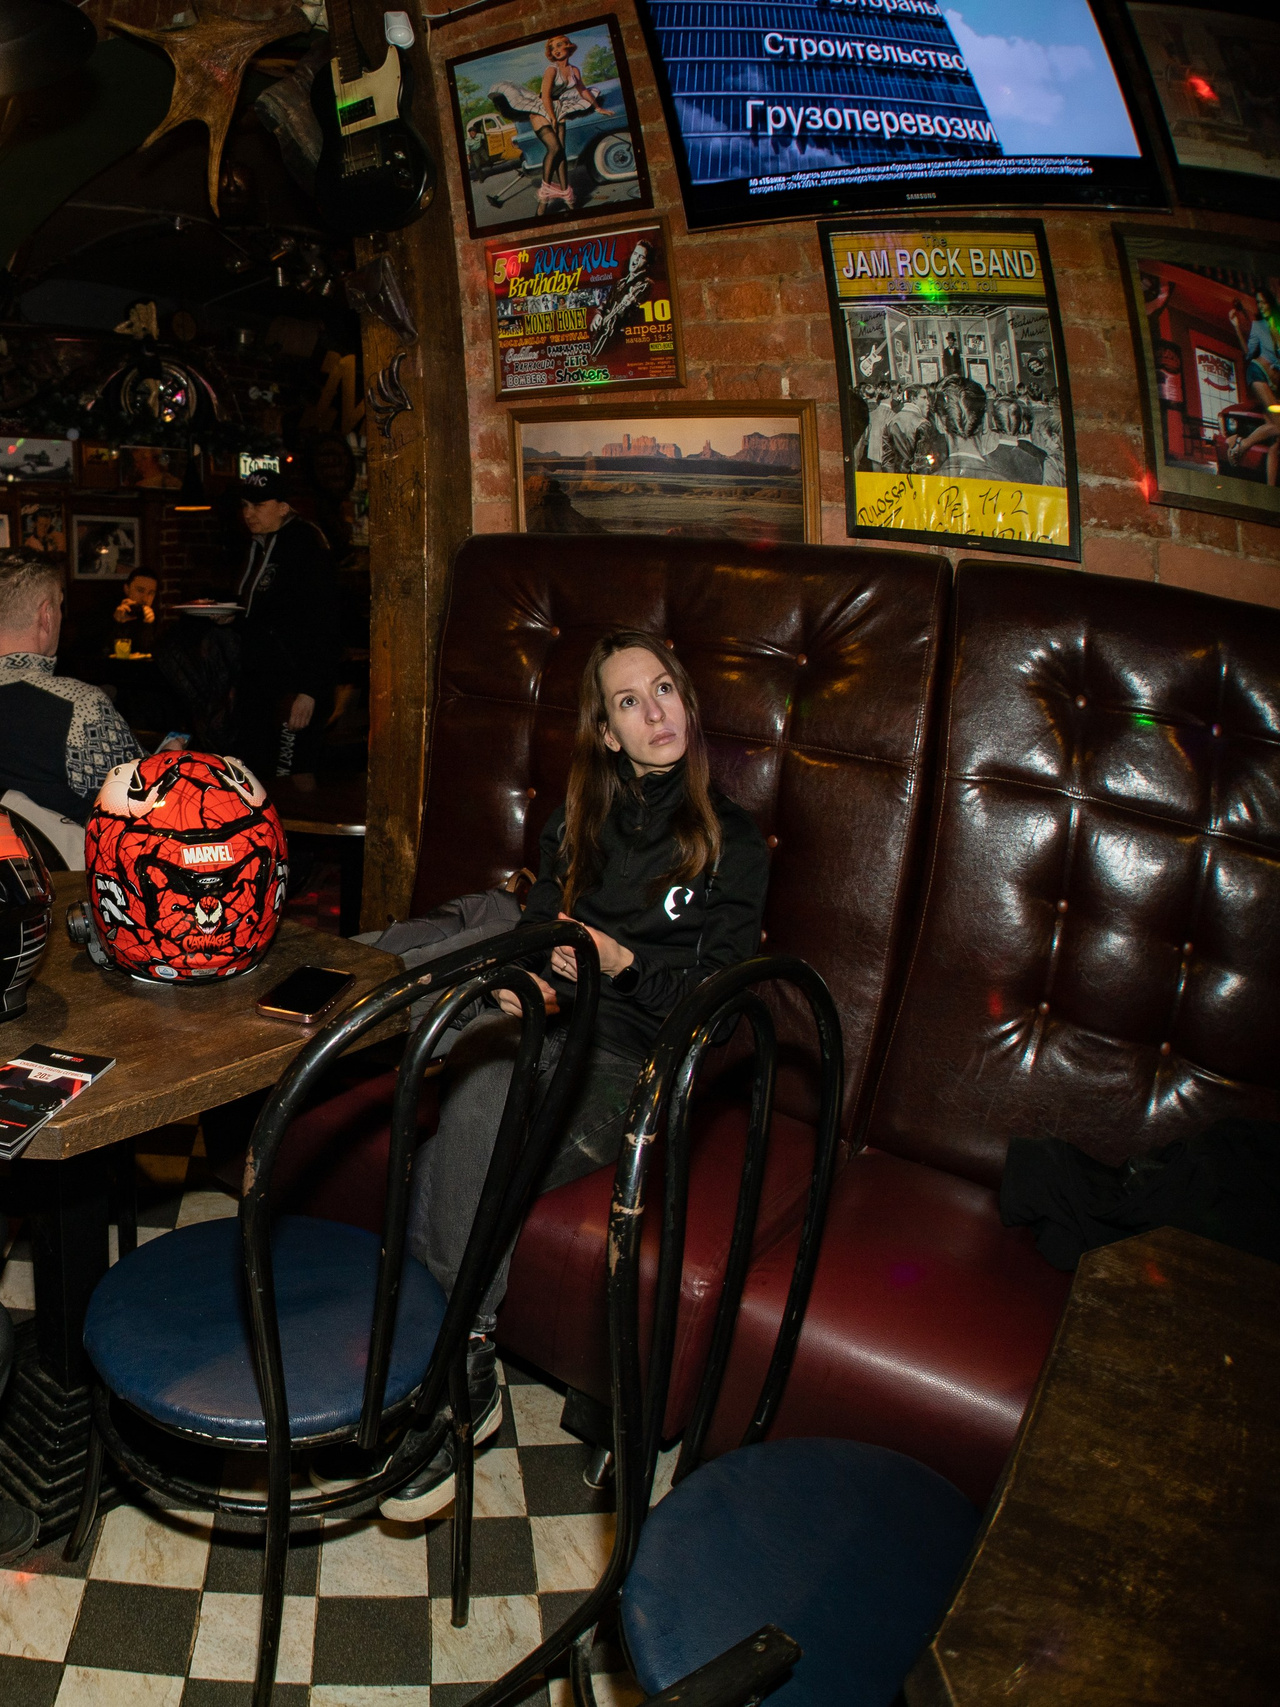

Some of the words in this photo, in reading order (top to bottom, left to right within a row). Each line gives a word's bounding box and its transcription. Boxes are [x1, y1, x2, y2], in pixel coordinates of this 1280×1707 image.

[764, 31, 969, 72] Строительство
[745, 99, 1001, 144] Грузоперевозки
[906, 192, 937, 200] SAMSUNG
[922, 234, 948, 248] The
[842, 250, 891, 279] JAM
[895, 248, 966, 278] ROCK
[969, 248, 1037, 279] BAND
[508, 265, 583, 298] Birthday!
[887, 278, 922, 294] plays
[976, 279, 998, 292] roll
[639, 299, 672, 322] 10
[525, 311, 556, 335] MONEY
[557, 307, 587, 332] HONEY
[625, 323, 673, 337] апреля
[514, 360, 555, 373] BARRACUDA
[506, 372, 547, 387] BOMBERS
[555, 367, 610, 383] Shakers
[183, 845, 233, 865] MARVEL
[182, 931, 231, 952] CARNAGE
[33, 1071, 53, 1081] 20%
